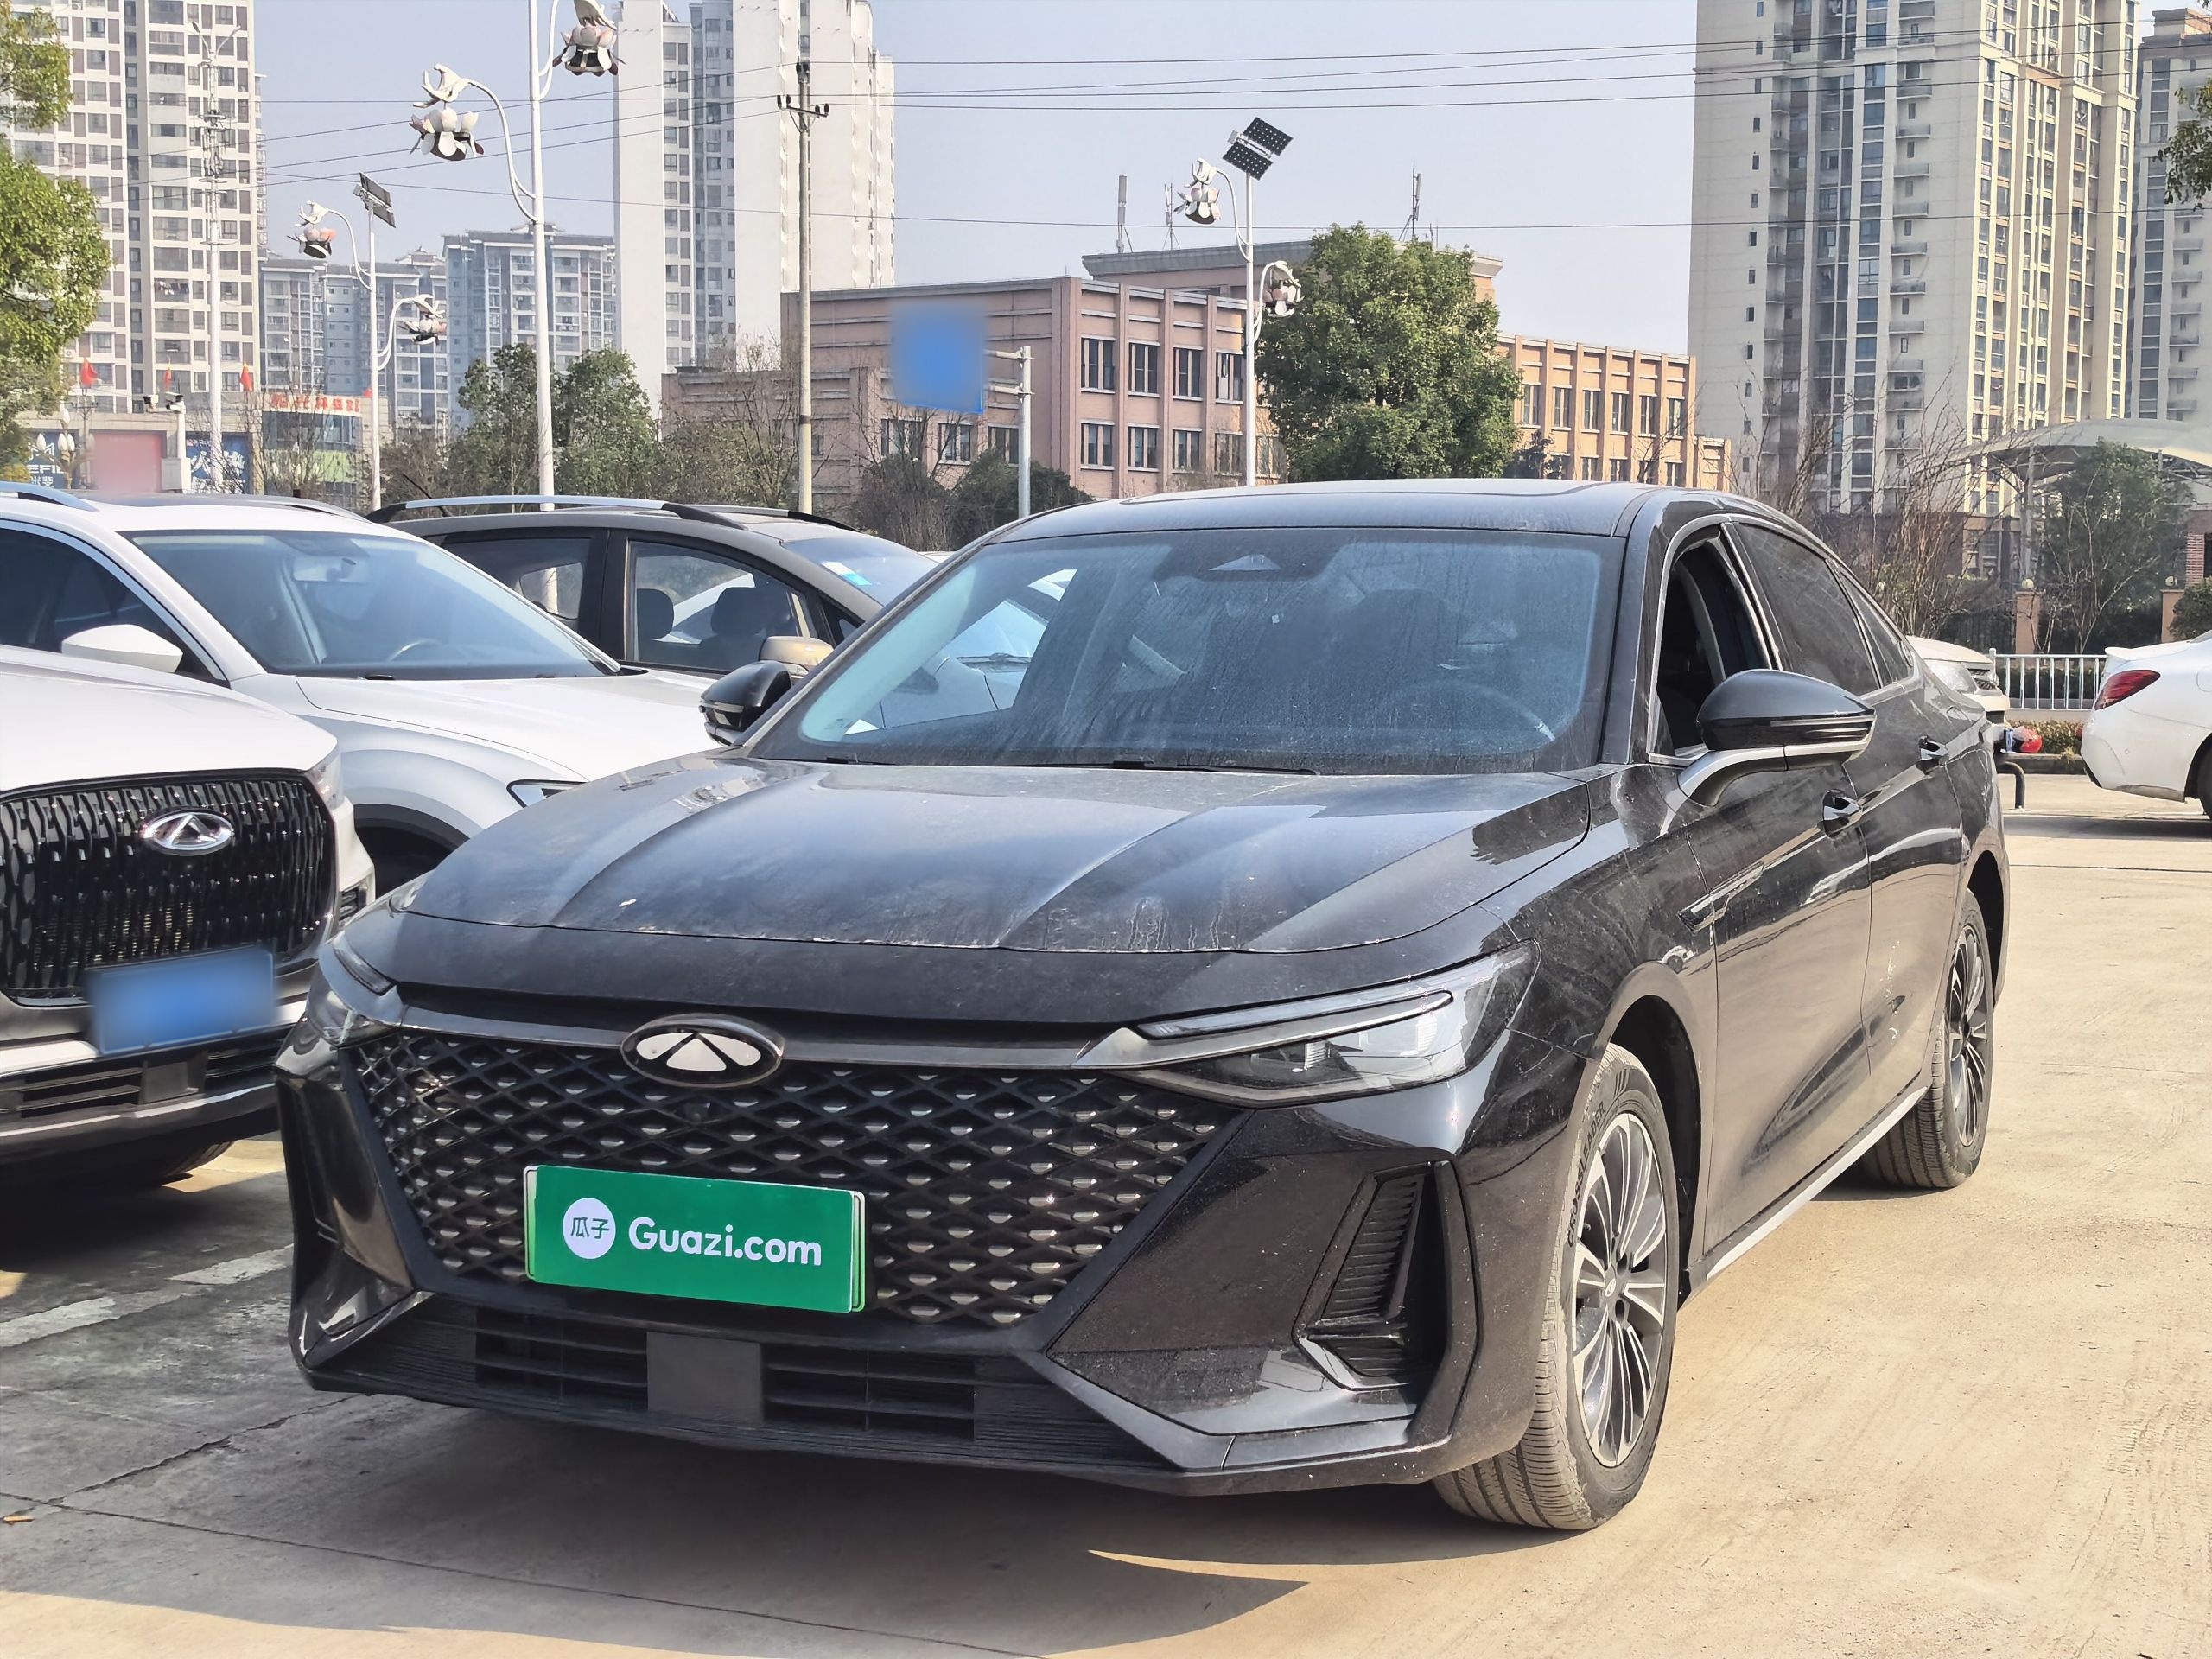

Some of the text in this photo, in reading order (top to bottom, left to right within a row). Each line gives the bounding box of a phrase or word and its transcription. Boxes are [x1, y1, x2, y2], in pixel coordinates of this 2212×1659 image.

[1567, 1101, 1605, 1248] CROSSLEADER
[570, 1217, 610, 1240] 瓜子
[628, 1217, 823, 1266] Guazi.com
